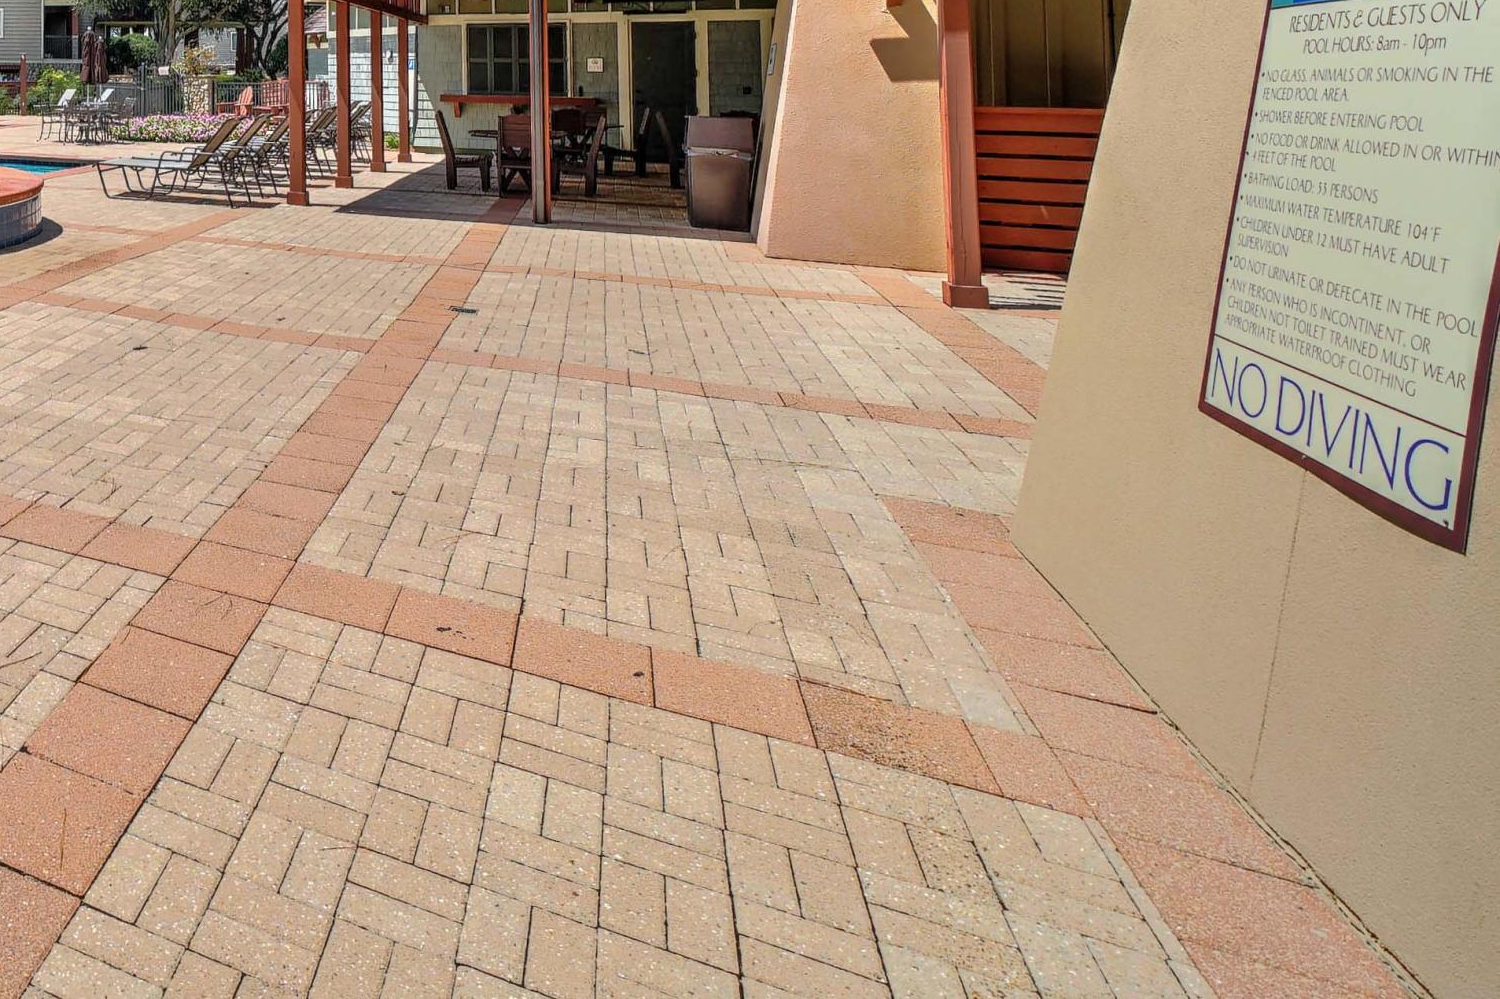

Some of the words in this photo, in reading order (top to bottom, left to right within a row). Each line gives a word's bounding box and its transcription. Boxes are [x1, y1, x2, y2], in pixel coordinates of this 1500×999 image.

[1289, 10, 1350, 33] RESIDENTS
[1353, 10, 1364, 27] &
[1367, 3, 1426, 27] GUESTS
[1303, 36, 1329, 54] POOL
[1332, 35, 1375, 52] HOURS:
[1377, 35, 1400, 50] 8am
[1412, 33, 1447, 56] 10pm
[1267, 69, 1279, 82] NO
[1311, 67, 1355, 82] ANIMALS
[1357, 67, 1373, 82] OR
[1376, 66, 1438, 82] SMOKING
[1442, 66, 1459, 82] IN
[1463, 66, 1494, 83] THE
[1263, 87, 1293, 101] FENCED
[1295, 87, 1318, 101] POOL
[1258, 109, 1292, 124] SHOWER
[1294, 111, 1328, 126] BEFORE
[1330, 112, 1387, 130] ENTERING
[1389, 115, 1424, 132] POOL
[1255, 132, 1268, 145] NO
[1269, 133, 1293, 148] FOOD
[1295, 134, 1308, 149] OR
[1310, 135, 1340, 152] DRINK
[1343, 139, 1400, 158] ALLOWED
[1403, 143, 1419, 159] IN
[1422, 145, 1442, 161] OR
[1258, 150, 1276, 164] FEET
[1276, 152, 1289, 166] OF
[1291, 153, 1307, 168] THE
[1310, 155, 1336, 172] POOL
[1248, 172, 1284, 189] BATHING
[1330, 183, 1379, 204] PERSONS
[1244, 194, 1286, 214] MAXIMUM
[1287, 201, 1319, 220] WATER
[1322, 206, 1401, 236] TEMPERATURE
[1237, 233, 1289, 258] SUPERVISION
[1240, 216, 1280, 236] CHILDREN
[1281, 224, 1314, 244] UNDER
[1316, 232, 1327, 248] 12
[1328, 234, 1360, 254] MUST
[1363, 241, 1398, 263] HAVE
[1401, 250, 1450, 274] ADULT
[1233, 254, 1245, 271] DO
[1248, 259, 1267, 278] NOT
[1268, 264, 1308, 289] URINATE
[1309, 275, 1324, 293] OR
[1326, 280, 1383, 311] DEFECATE
[1386, 297, 1401, 315] IN
[1404, 302, 1431, 324] THE
[1436, 310, 1478, 338] POOL
[1230, 277, 1247, 295] ANY
[1248, 282, 1281, 304] PERSON
[1283, 294, 1308, 313] WHO
[1309, 301, 1318, 318] IS
[1410, 334, 1431, 355] OR
[1225, 313, 1276, 343] APPROPRIATE
[1278, 331, 1346, 370] WATERPROOF
[1348, 358, 1416, 398] CLOTHING
[1227, 295, 1267, 319] CHILDREN
[1269, 309, 1290, 328] NOT
[1293, 316, 1327, 342] TOILET
[1329, 329, 1378, 360] TRAINED
[1380, 345, 1420, 375] MUST
[1422, 361, 1467, 391] WEAR
[1210, 347, 1268, 418] NO
[1275, 376, 1453, 512] DIVING
